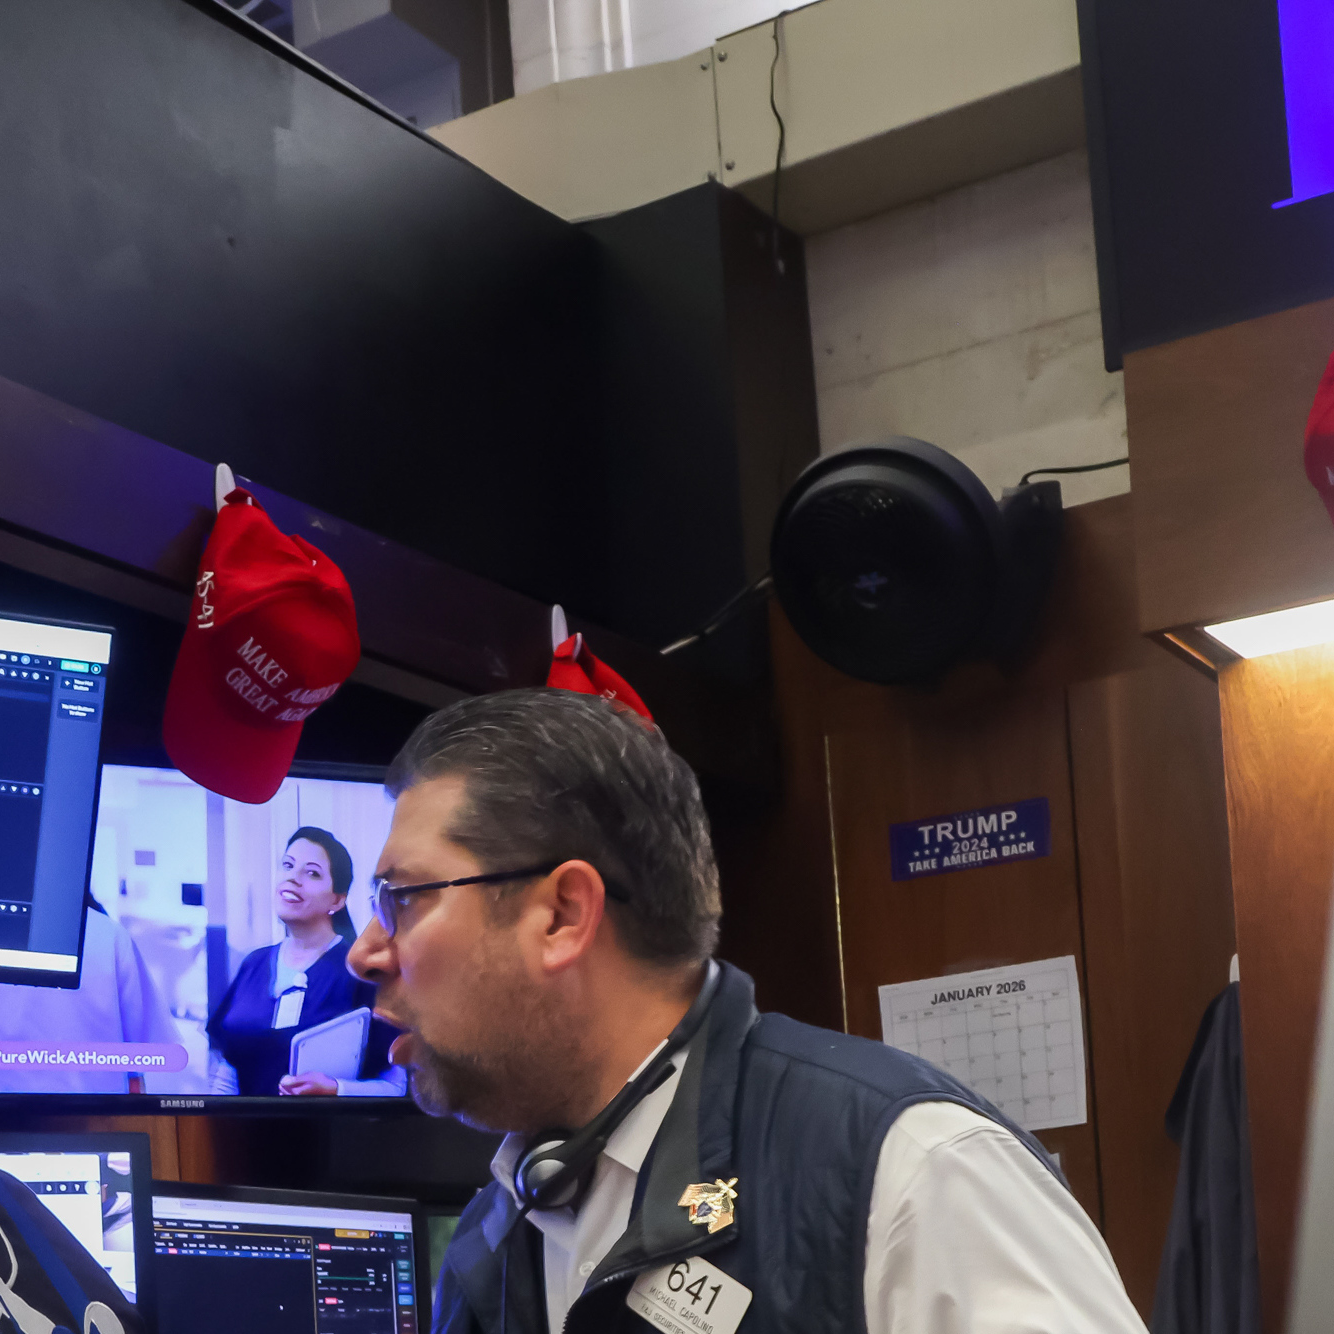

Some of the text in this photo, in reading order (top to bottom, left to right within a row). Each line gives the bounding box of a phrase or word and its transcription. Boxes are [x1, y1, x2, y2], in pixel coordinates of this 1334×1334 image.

[237, 637, 288, 688] MAKE
[226, 668, 278, 712] GREAT
[919, 811, 1017, 844] TRUMP
[909, 841, 1035, 872] TAKE AMERICA BACK
[953, 837, 989, 854] 2024
[931, 980, 1026, 1005] JANUARY 2026
[160, 1100, 205, 1109] SAMSUNG
[668, 1262, 722, 1315] 641
[649, 1286, 713, 1334] MICHAEL CAPOLINO
